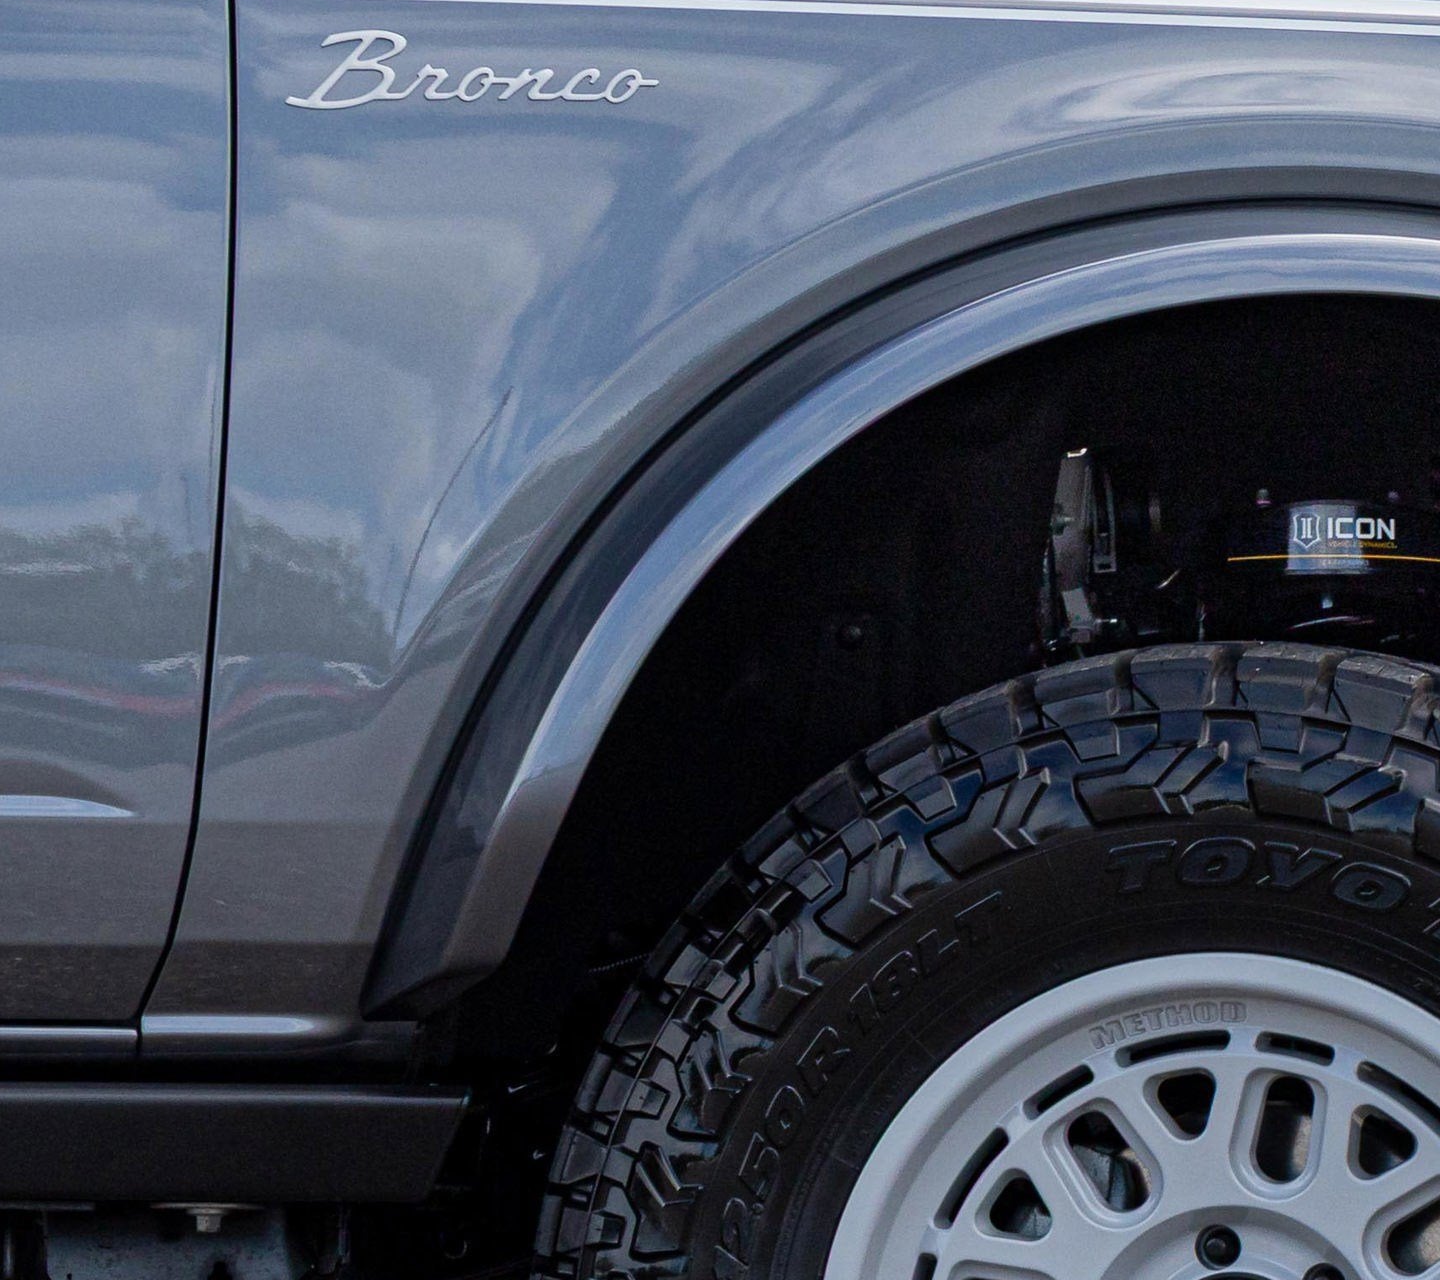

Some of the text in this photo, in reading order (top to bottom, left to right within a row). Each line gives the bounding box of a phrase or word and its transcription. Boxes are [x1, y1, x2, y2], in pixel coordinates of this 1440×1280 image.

[284, 28, 660, 111] Bronco
[1326, 516, 1397, 541] ICON
[1104, 835, 1414, 913] TOYO
[1088, 1000, 1249, 1050] METHOD
